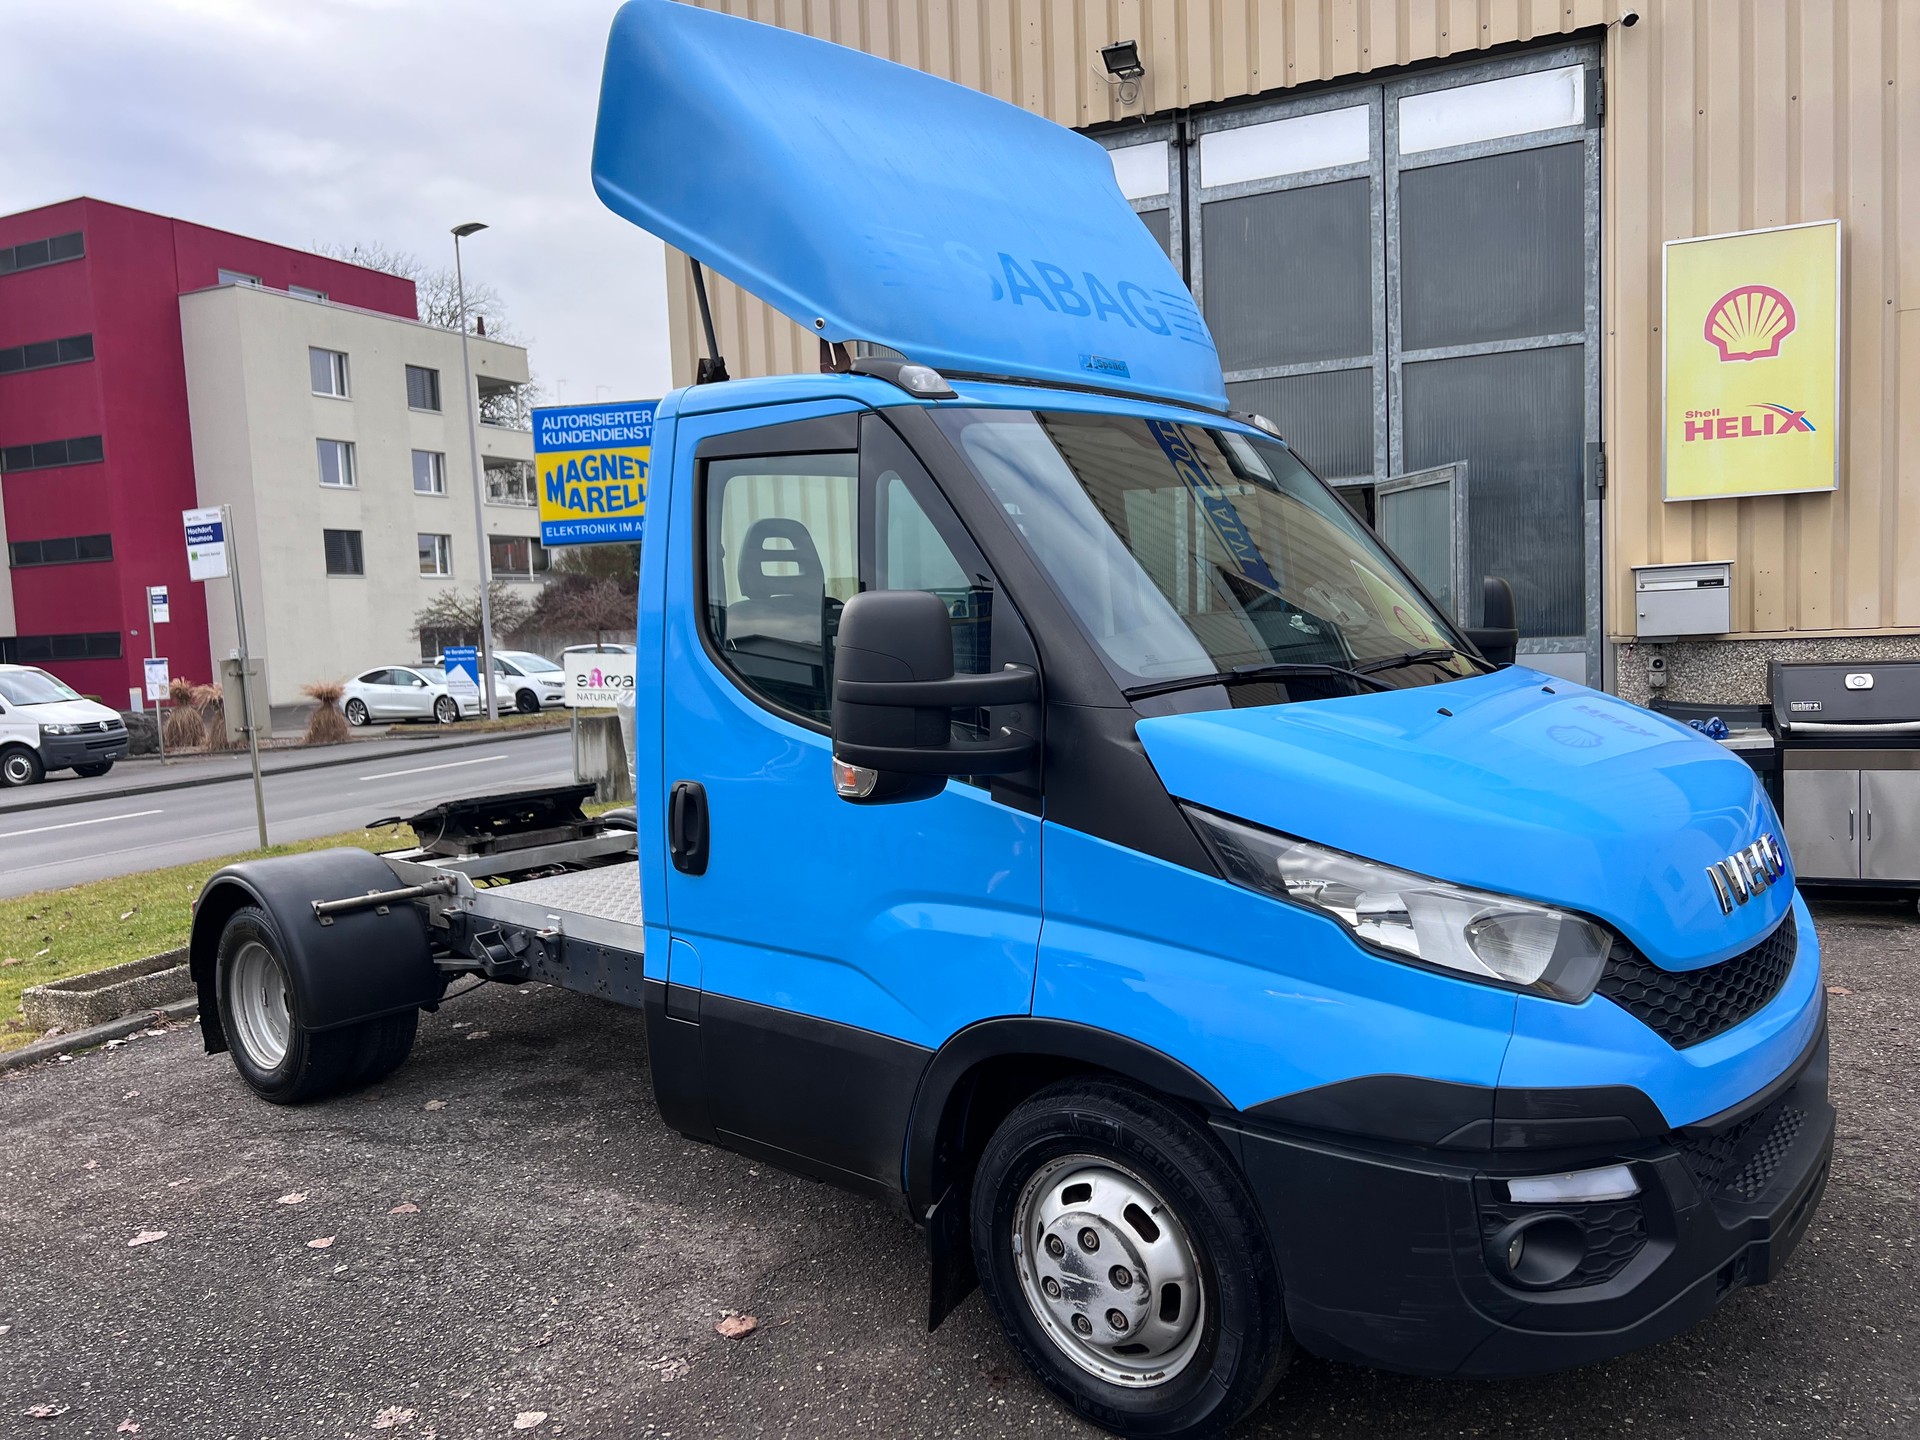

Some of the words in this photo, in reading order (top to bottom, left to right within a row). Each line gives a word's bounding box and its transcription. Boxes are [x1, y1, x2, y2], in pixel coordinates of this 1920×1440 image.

[942, 240, 1172, 336] SABAG
[541, 410, 652, 430] AUTORISIERTER
[1684, 408, 1811, 442] HELIX
[1685, 408, 1720, 419] Shell
[542, 426, 652, 445] KUNDENDIENST
[545, 454, 649, 507] MAGNET
[545, 483, 648, 513] MARELL
[546, 523, 618, 537] ELEKTRONIK
[619, 522, 633, 532] IM
[635, 521, 645, 532] A
[1704, 832, 1786, 916] IVECO
